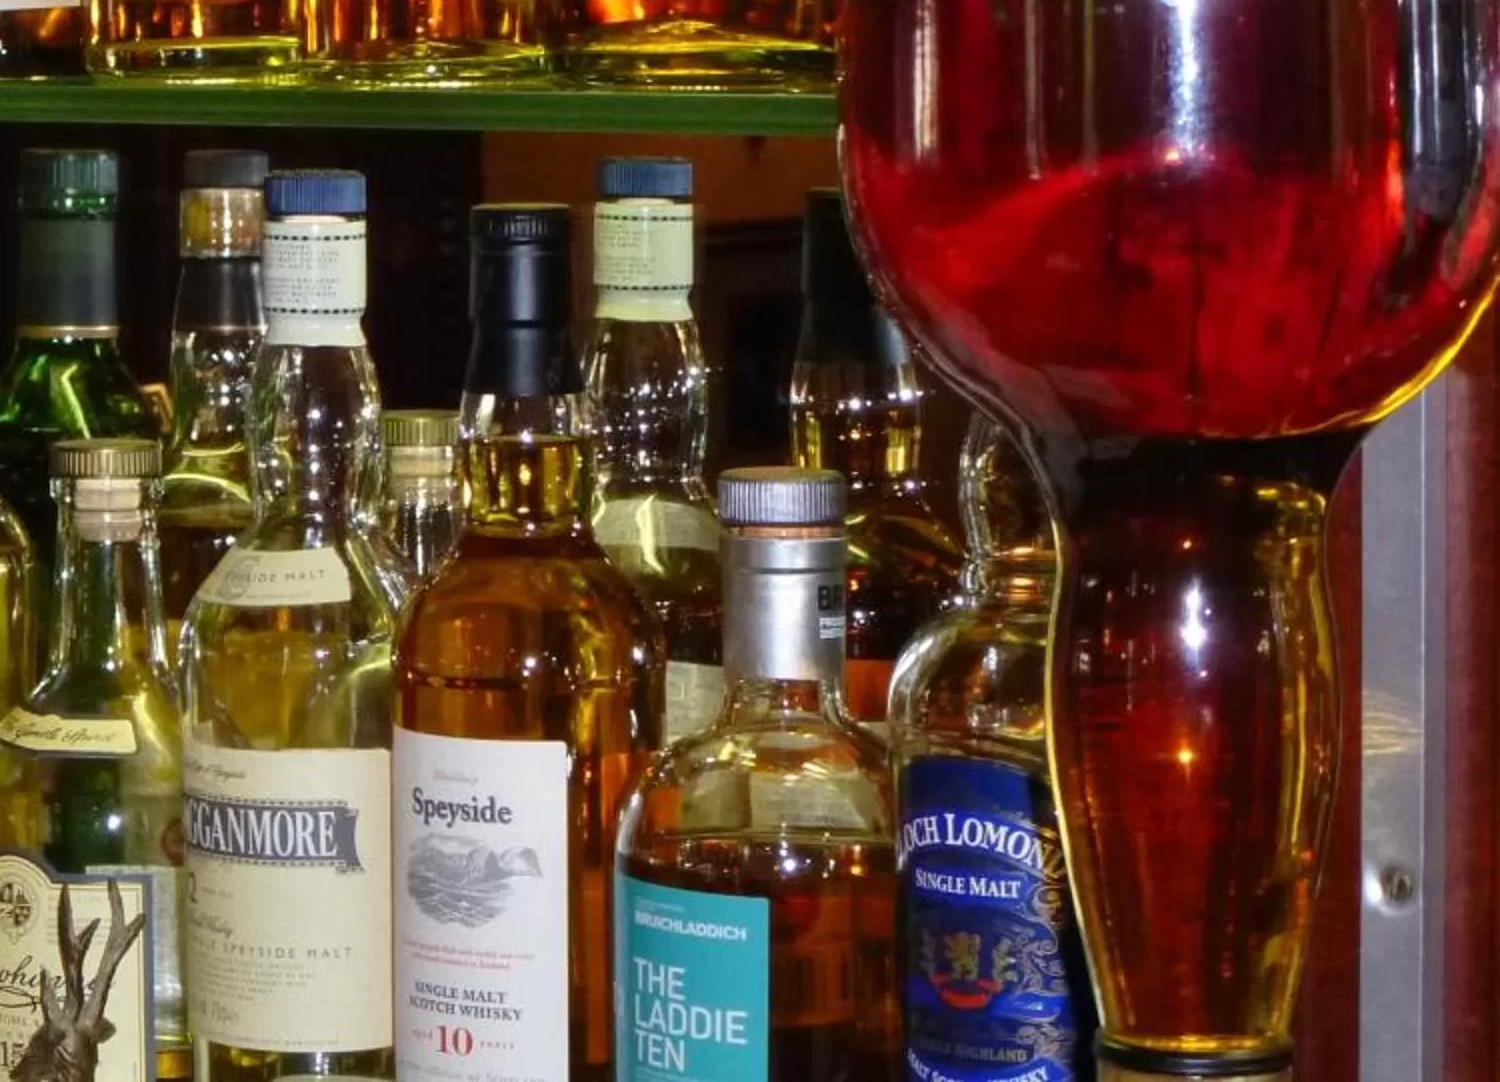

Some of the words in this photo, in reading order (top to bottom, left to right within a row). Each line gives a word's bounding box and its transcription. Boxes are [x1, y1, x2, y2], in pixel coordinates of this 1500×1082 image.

[411, 785, 514, 827] Speyside
[896, 815, 942, 871] LOCH
[915, 869, 966, 894] SINGLE
[969, 876, 1021, 899] MALT
[633, 909, 748, 941] BRUICHLADDICH
[223, 942, 296, 960] SPEYSIDE
[307, 946, 353, 960] MALT
[414, 980, 458, 999] SINGLE
[462, 987, 508, 1004] MALT
[632, 956, 687, 1002] THE
[408, 994, 456, 1015] SCOTCH
[459, 1003, 523, 1021] WHISKY
[634, 992, 749, 1045] LADDIE
[435, 1025, 474, 1056] 10
[634, 1027, 685, 1073] TEN
